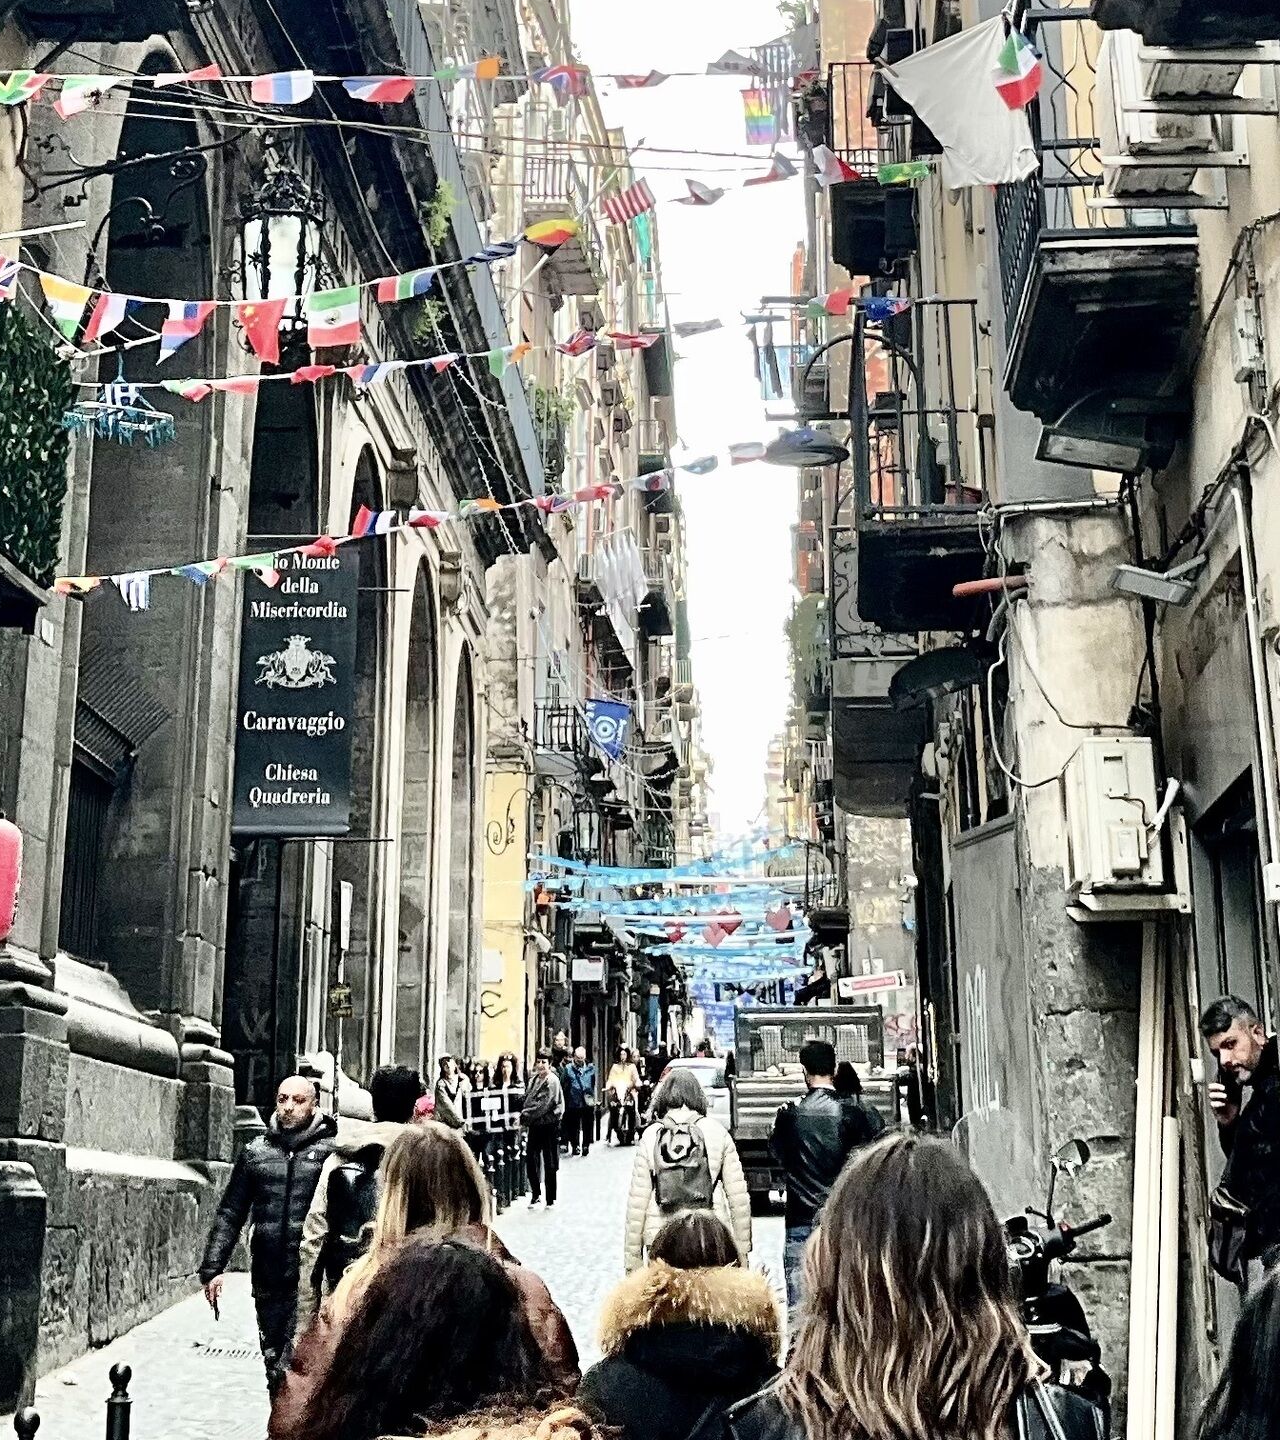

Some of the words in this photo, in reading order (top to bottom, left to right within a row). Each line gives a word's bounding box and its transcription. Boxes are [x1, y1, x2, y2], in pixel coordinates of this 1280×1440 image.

[273, 553, 288, 570] io
[291, 553, 340, 570] Monte
[280, 577, 319, 594] della
[250, 601, 348, 618] Misericordia
[243, 711, 345, 736] Caravaggio
[265, 763, 318, 781] Chiesa
[249, 787, 331, 808] Quadreria
